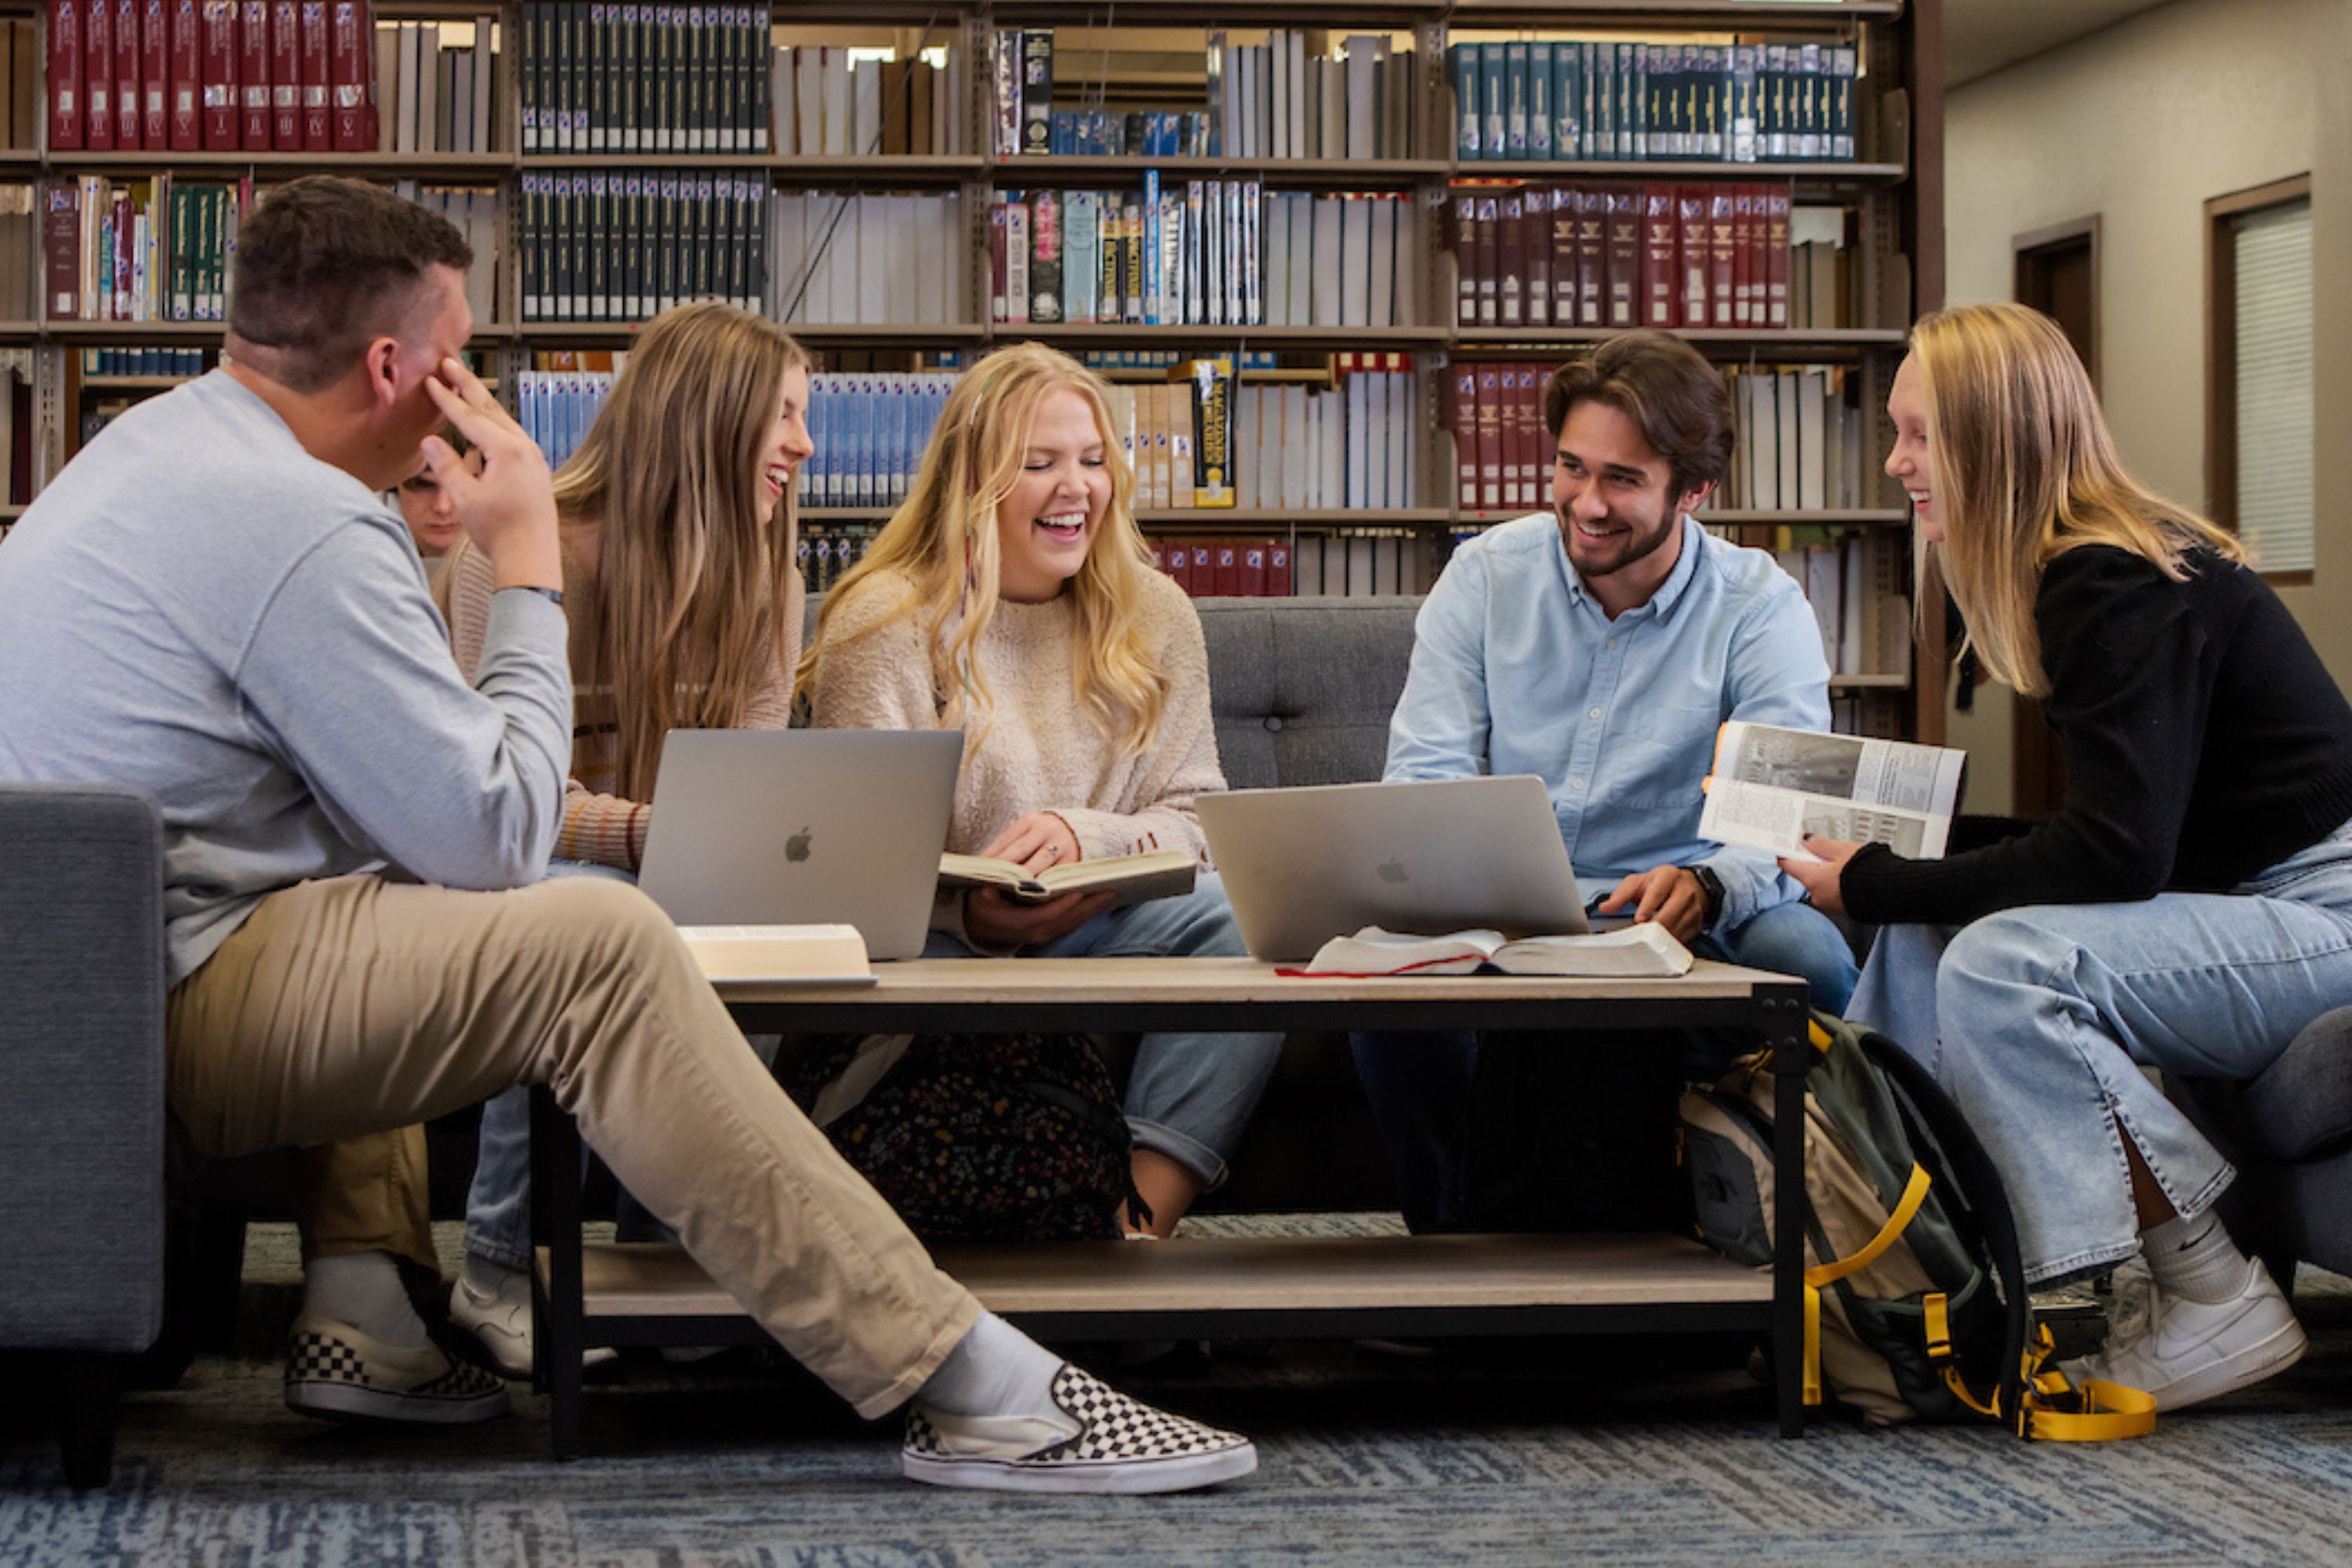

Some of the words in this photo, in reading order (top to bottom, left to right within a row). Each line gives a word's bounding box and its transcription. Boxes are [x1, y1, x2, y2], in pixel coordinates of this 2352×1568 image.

[64, 119, 69, 130] I
[94, 119, 103, 130] II
[122, 119, 133, 131] III
[148, 118, 162, 131] IV
[180, 118, 190, 130] V
[218, 115, 224, 129] I
[251, 117, 260, 130] II
[280, 117, 292, 130] III
[309, 117, 323, 131] IV
[343, 117, 353, 130] V
